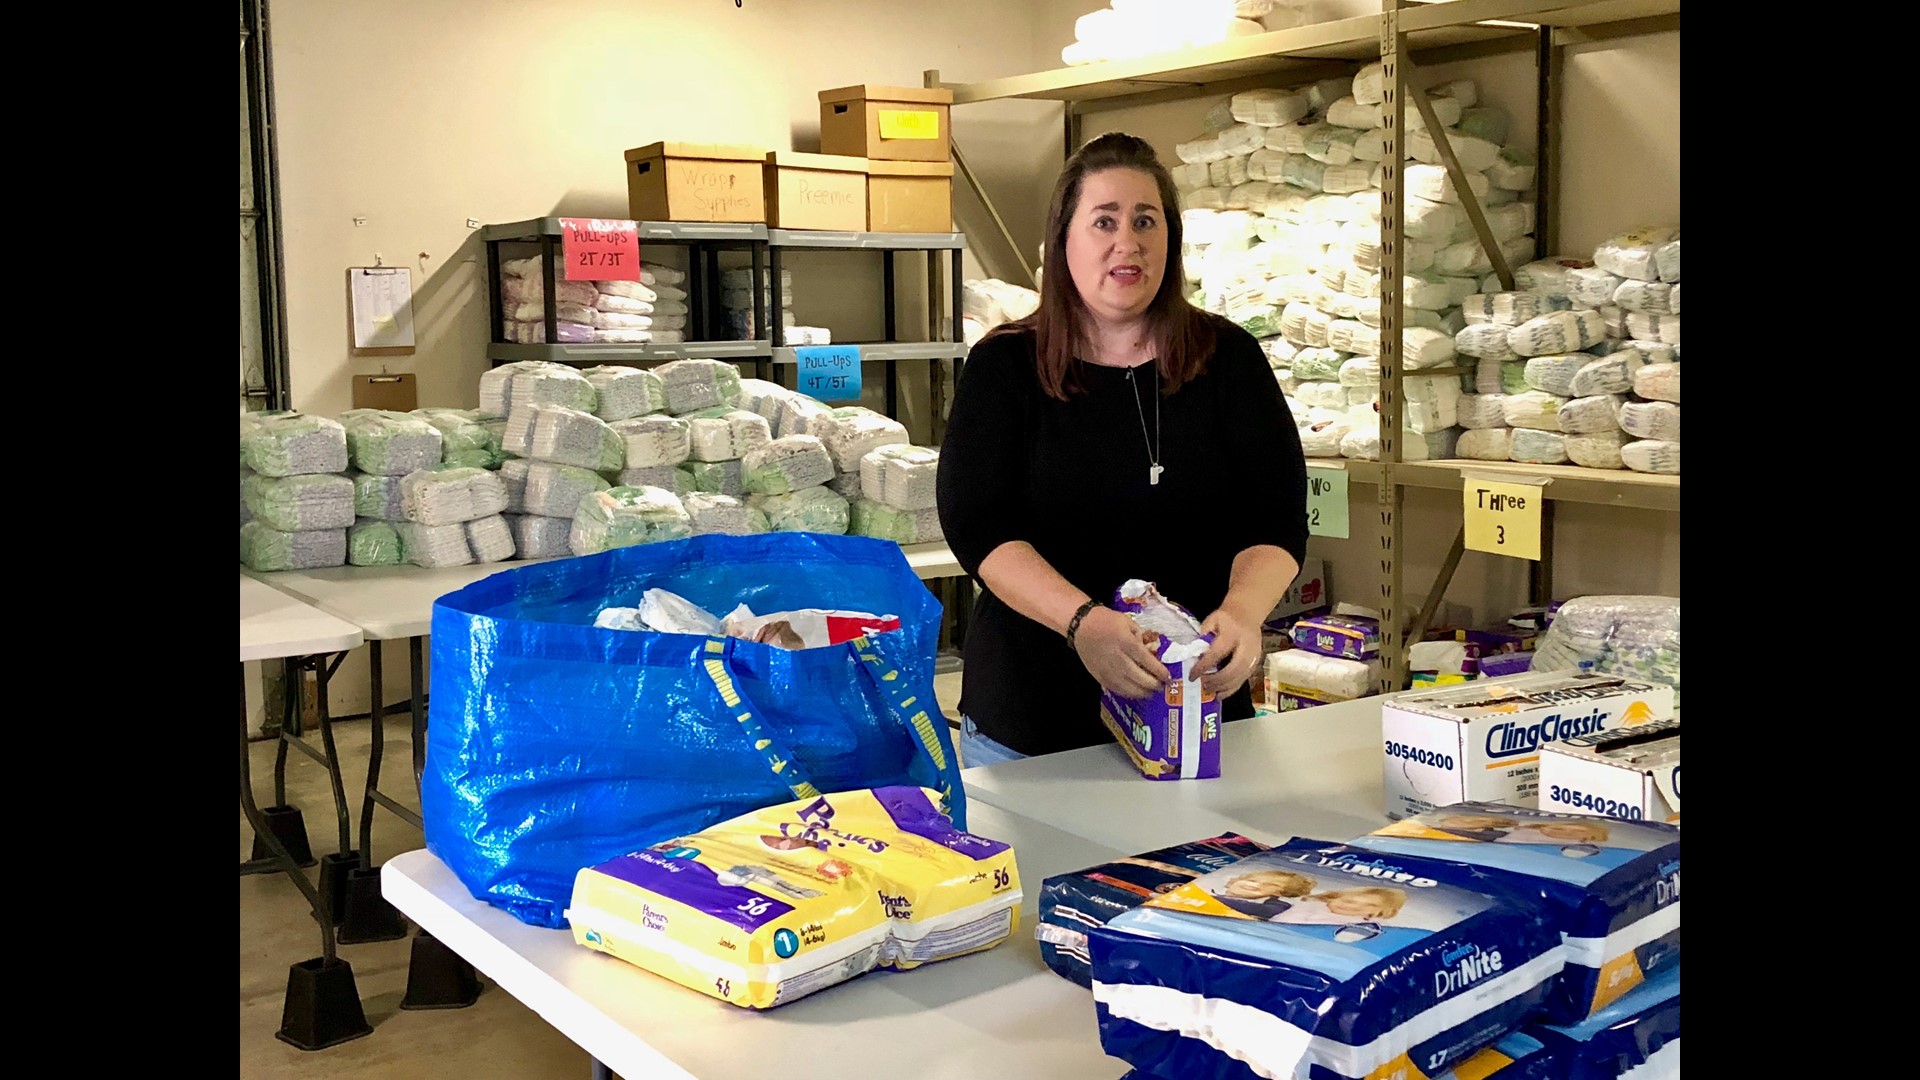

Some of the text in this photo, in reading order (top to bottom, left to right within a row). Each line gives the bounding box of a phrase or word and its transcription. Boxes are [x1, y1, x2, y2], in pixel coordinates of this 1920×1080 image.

[799, 179, 854, 205] Preemie
[1311, 508, 1320, 526] 2
[1496, 525, 1505, 545] 3
[1486, 708, 1607, 759] ClingClassic
[1385, 740, 1454, 771] 30540200
[1550, 785, 1642, 820] 30540200
[993, 866, 1010, 889] 56
[737, 896, 774, 916] 56
[778, 931, 792, 953] 1
[1435, 950, 1503, 998] DriNite
[1428, 1049, 1448, 1070] 17
